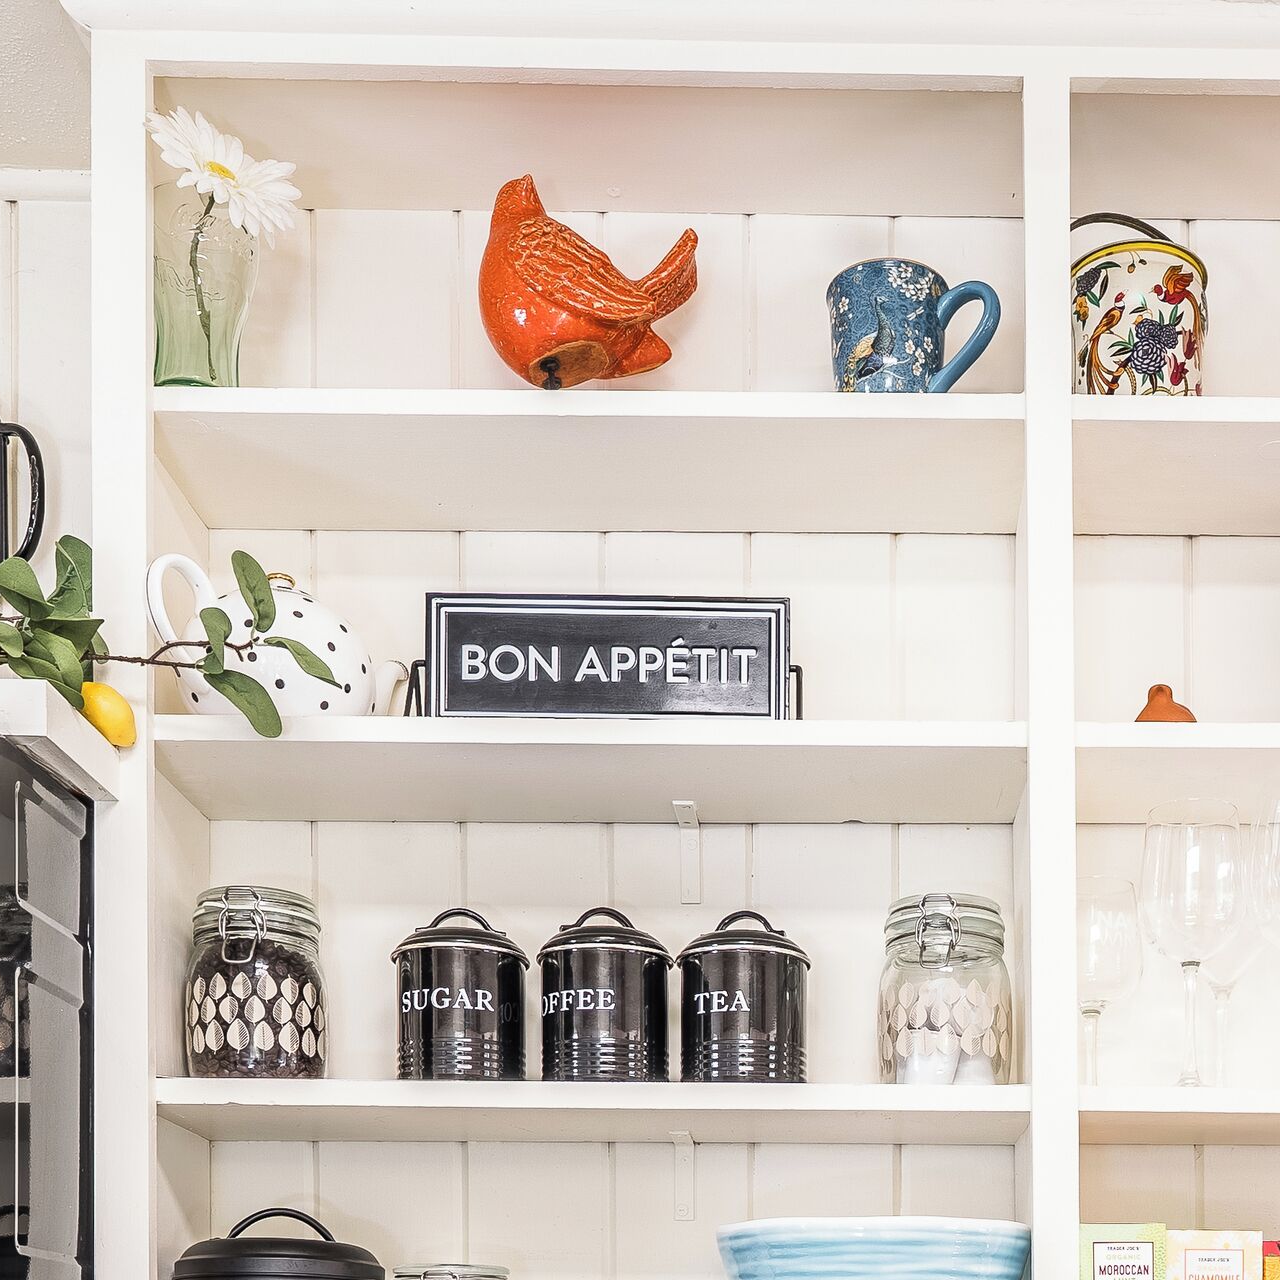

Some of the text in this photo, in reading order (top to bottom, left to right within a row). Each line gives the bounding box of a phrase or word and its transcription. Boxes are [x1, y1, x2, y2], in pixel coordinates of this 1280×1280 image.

[461, 637, 757, 685] BON APPÉTIT
[401, 988, 494, 1013] SUGAR
[694, 988, 750, 1015] TEA
[1099, 1265, 1149, 1275] MOROCCAN
